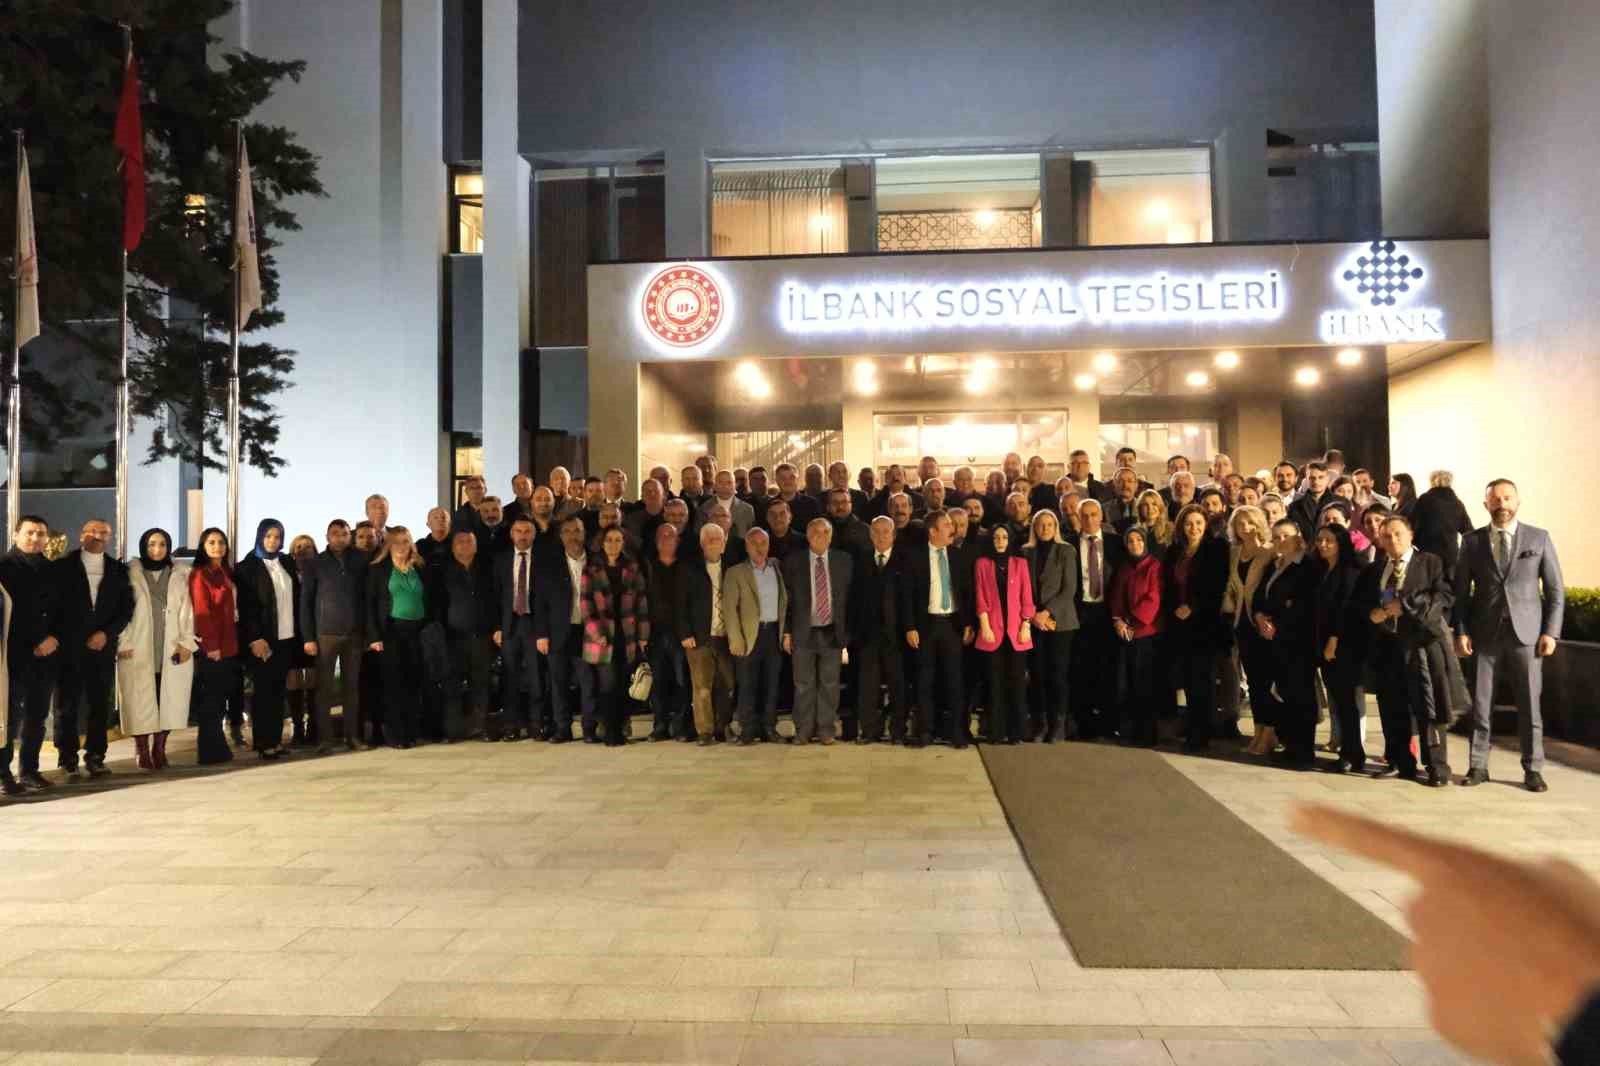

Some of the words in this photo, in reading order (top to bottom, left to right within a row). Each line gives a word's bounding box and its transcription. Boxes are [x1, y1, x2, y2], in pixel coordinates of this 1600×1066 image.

[787, 287, 923, 321] İLBANK
[935, 287, 1076, 317] SOSYAL
[1088, 272, 1278, 314] TESİSLERİ
